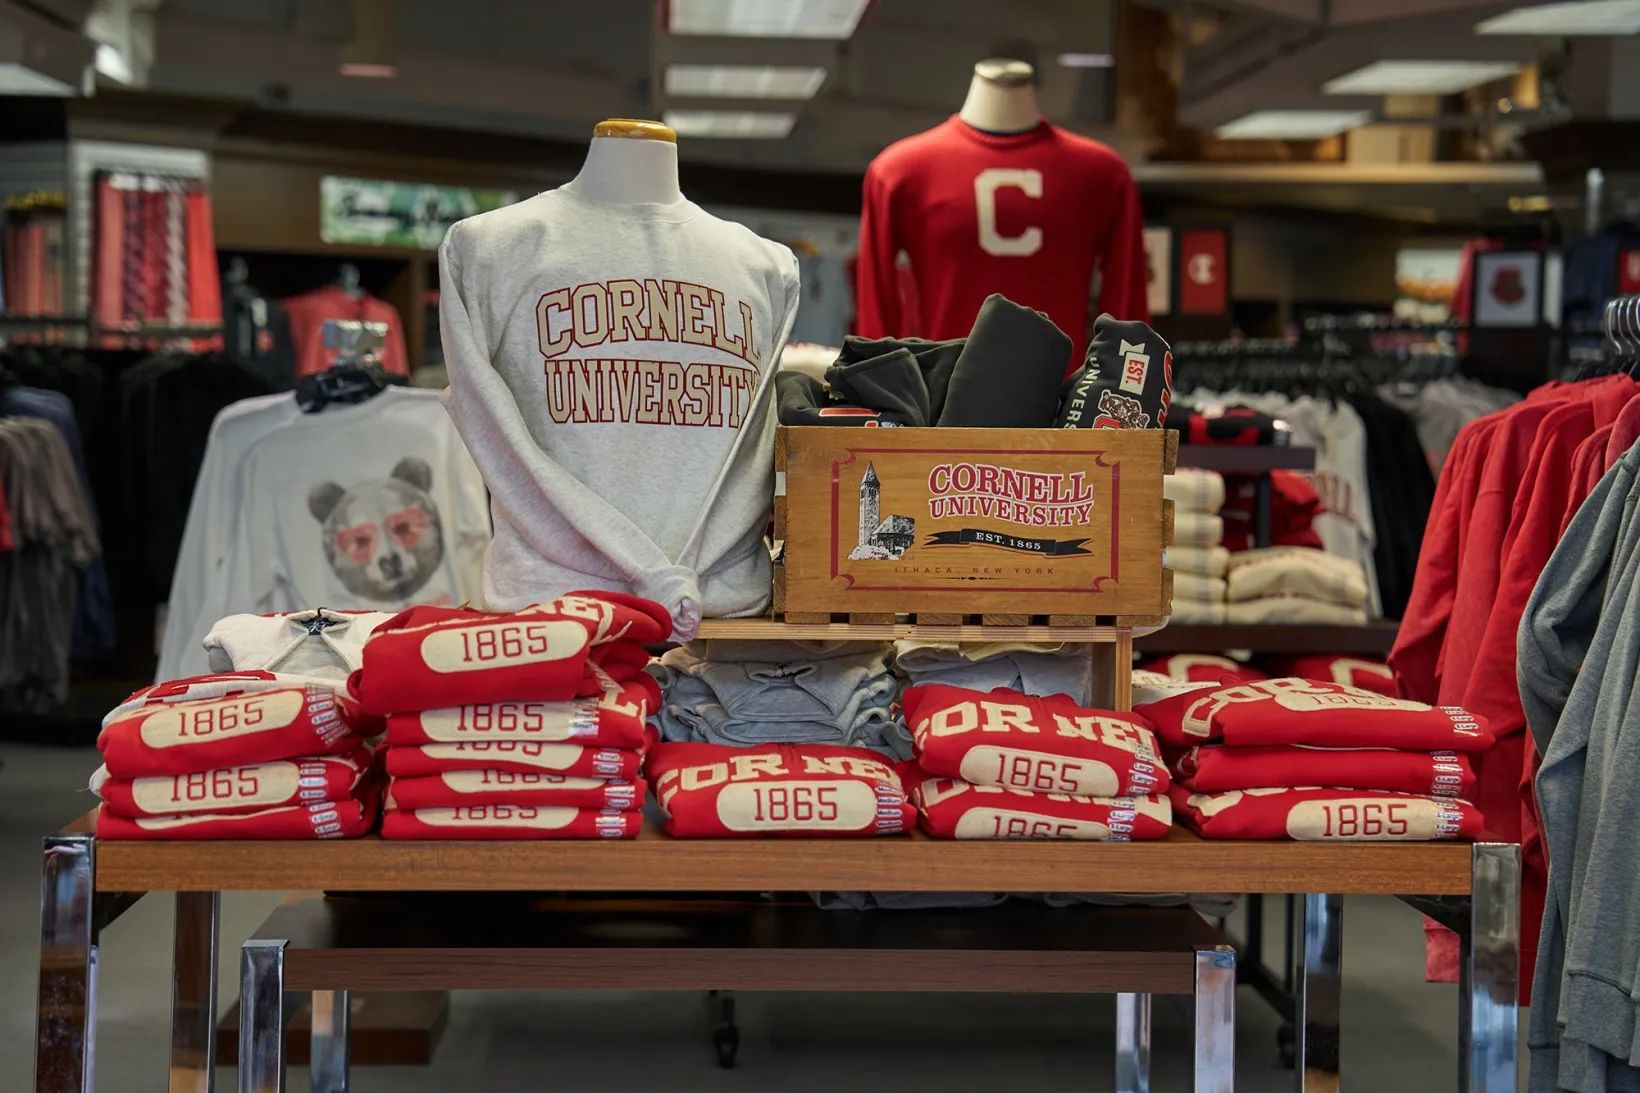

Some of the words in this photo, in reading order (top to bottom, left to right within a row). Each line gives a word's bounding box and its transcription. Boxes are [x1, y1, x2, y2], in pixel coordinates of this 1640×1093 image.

[974, 168, 1043, 256] C
[536, 279, 761, 376] CORNELL
[1125, 359, 1145, 385] EST.
[545, 358, 758, 429] UNIVERSITY
[928, 462, 1094, 504] CORNELL
[928, 495, 1094, 527] UNIVERSITY
[975, 531, 1006, 545] EST.
[1009, 538, 1041, 550] 1865
[972, 567, 1003, 575] NEW
[1014, 567, 1054, 575] YORK
[461, 625, 548, 662] 1865
[178, 699, 264, 737] 1865
[457, 702, 545, 732] 1865
[171, 766, 260, 802] 1865
[994, 754, 1083, 793] 1865
[1133, 775, 1152, 784] Large
[1135, 763, 1154, 772] Large
[753, 787, 838, 822] 1865
[1323, 803, 1409, 837] 1865
